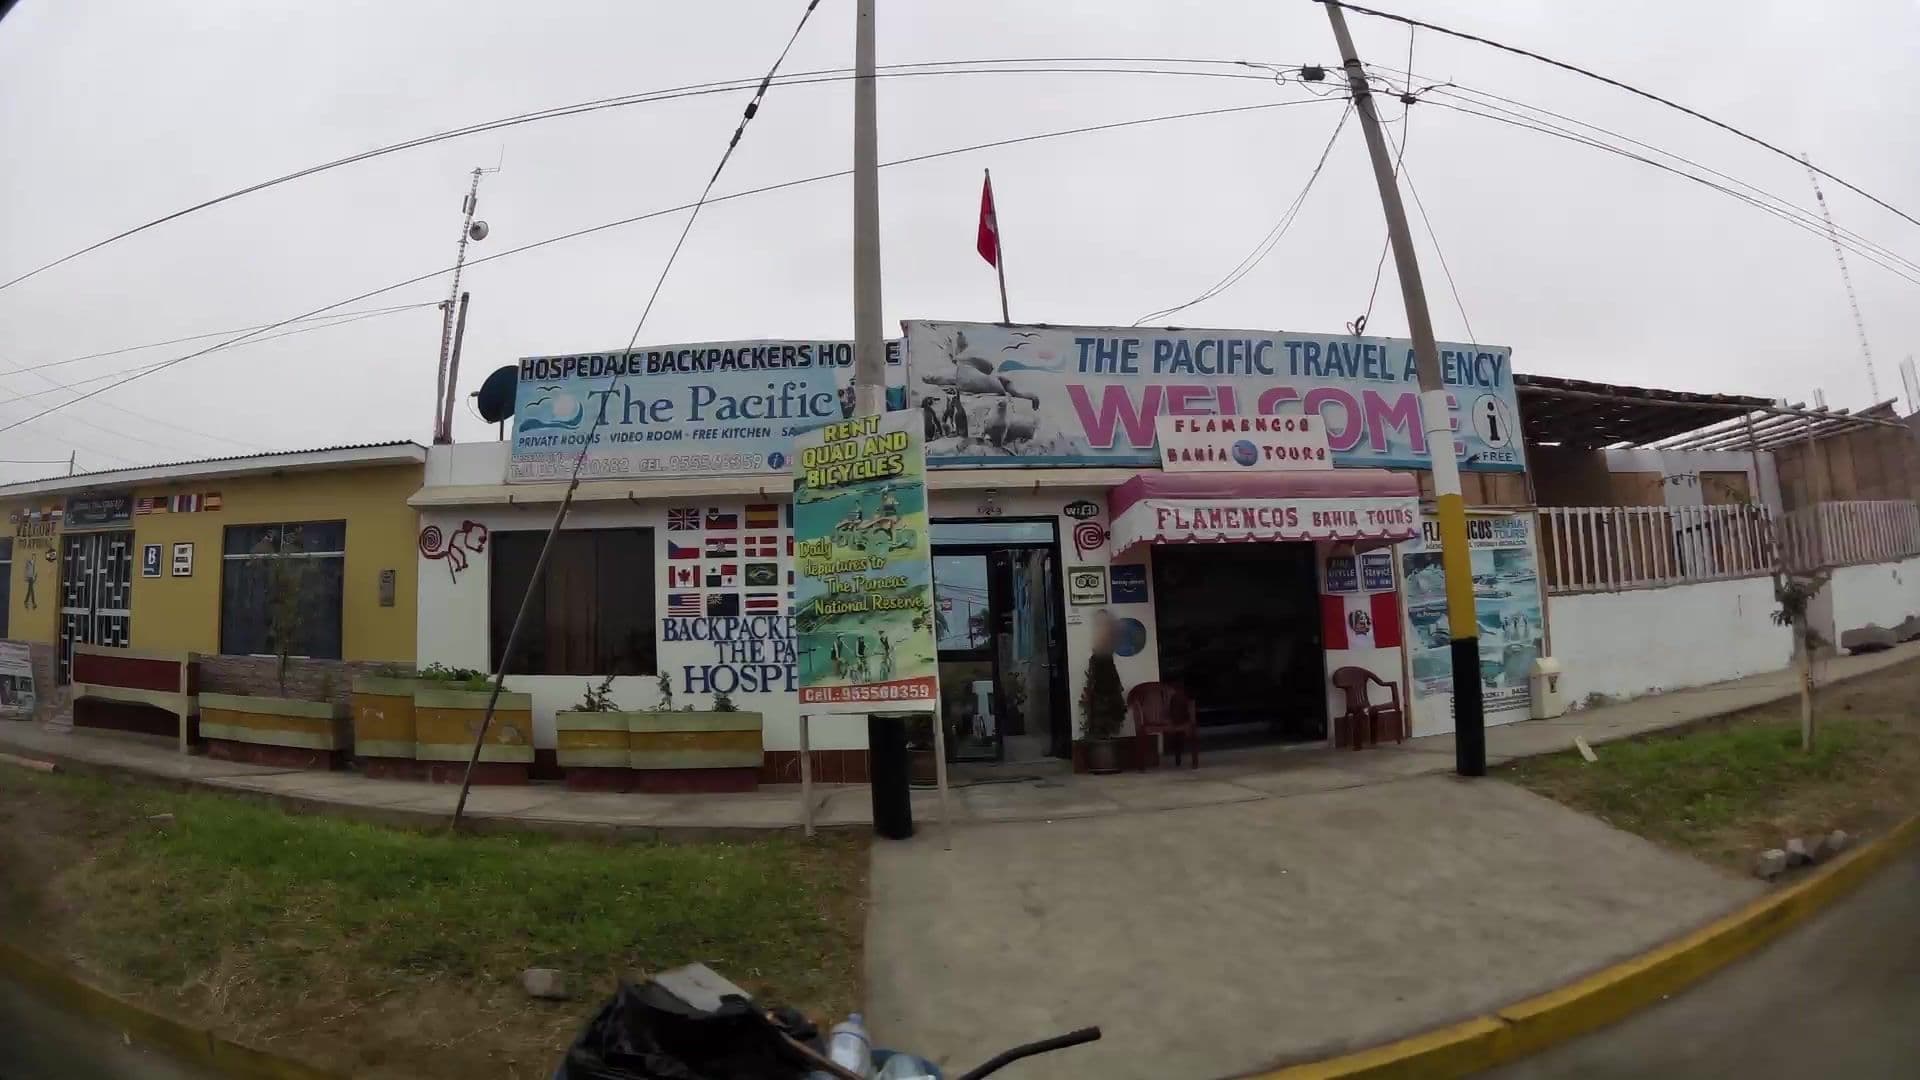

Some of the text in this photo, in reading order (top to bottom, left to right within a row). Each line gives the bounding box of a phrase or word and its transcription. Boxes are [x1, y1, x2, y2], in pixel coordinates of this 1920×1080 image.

[521, 342, 901, 380] HOSPEDAJE BACKPACKERS HOE
[1075, 337, 1504, 388] THE PACIFIC TRAVEL AENCY
[587, 380, 834, 426] The Pacific
[519, 435, 560, 448] PRIVATE
[560, 433, 601, 446] ROOMS
[610, 431, 644, 443] VIDEO
[646, 430, 683, 441] ROOM
[692, 428, 719, 440] FREE
[721, 427, 771, 439] KITCHEN
[824, 415, 881, 443] RENT
[1175, 418, 1310, 434] FLAMENCOS
[802, 431, 909, 469] QUAD AND
[1263, 445, 1326, 461] TOURS
[1482, 451, 1513, 462] FREE
[806, 454, 905, 490] BICYCLES
[1156, 507, 1413, 530] FLAMENCOS BAHIA TOURS
[799, 537, 833, 559] Daily
[804, 554, 885, 580] departures to
[825, 576, 850, 595] The
[814, 593, 924, 615] National Reserve
[713, 640, 766, 664] THE
